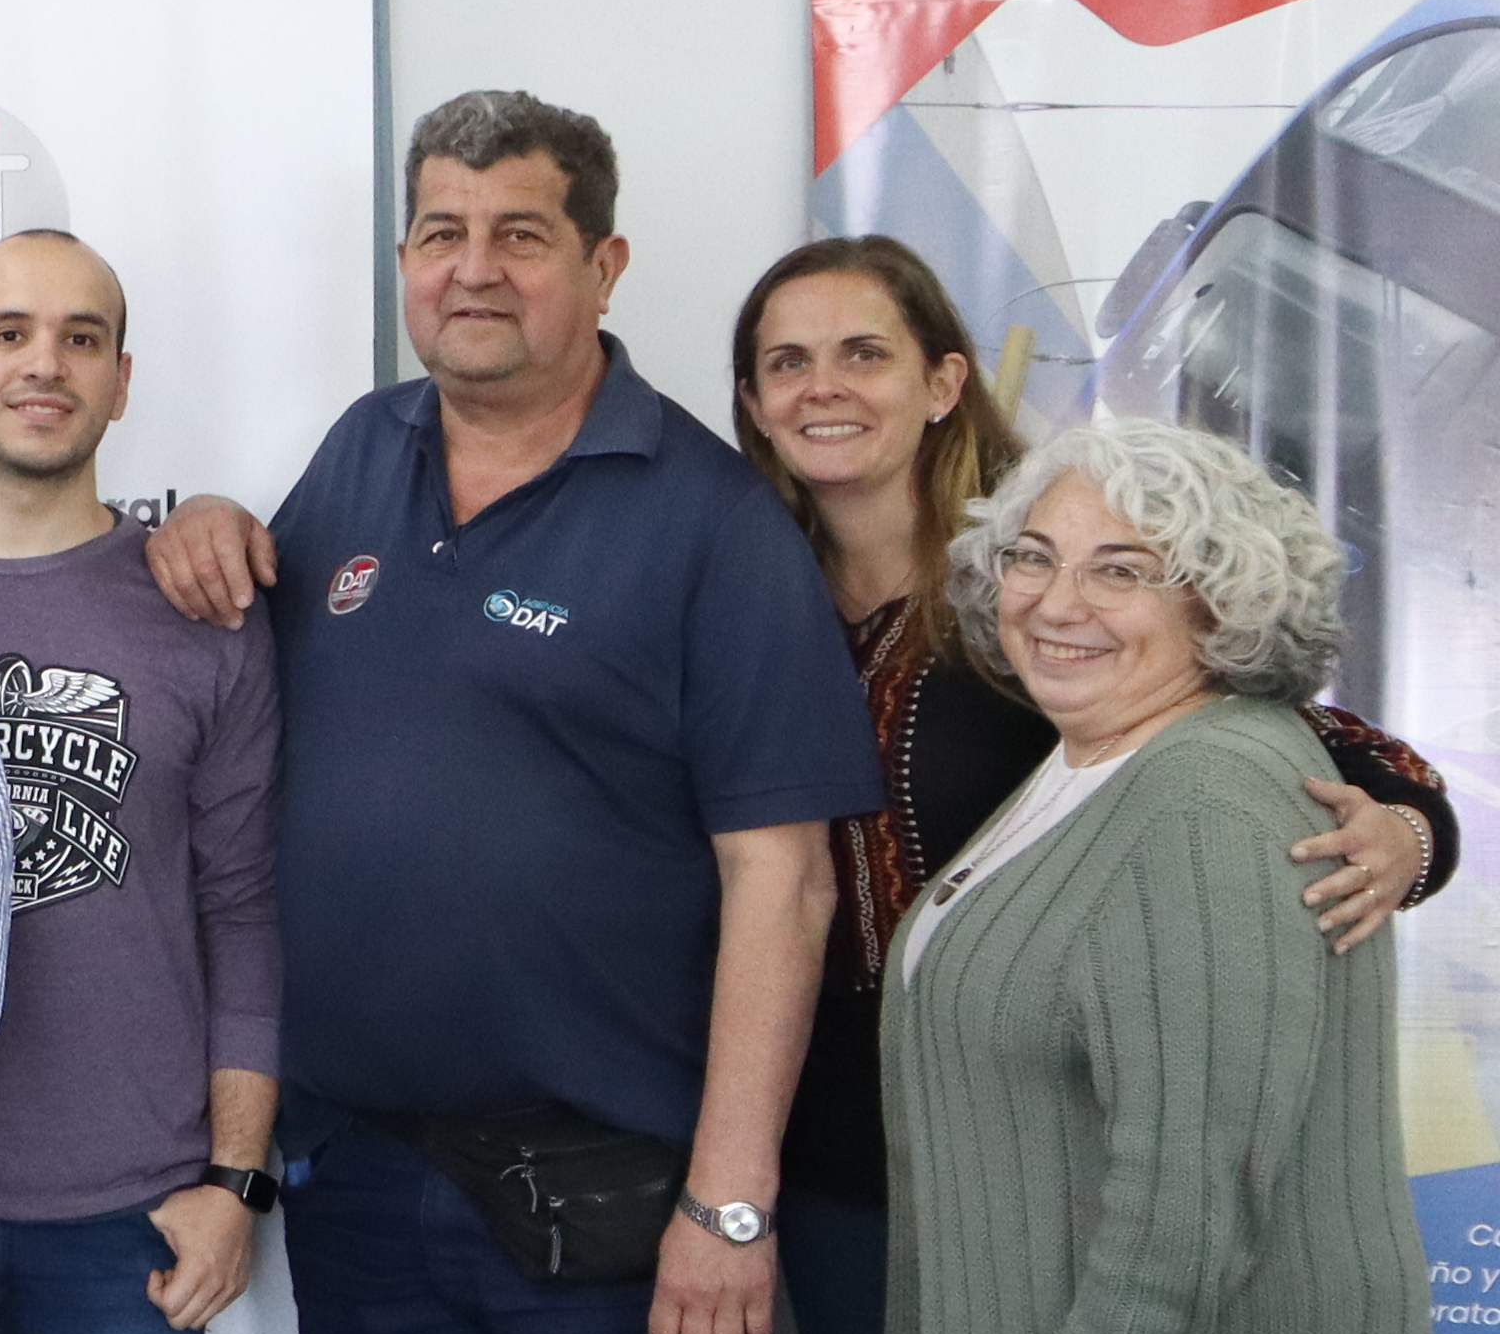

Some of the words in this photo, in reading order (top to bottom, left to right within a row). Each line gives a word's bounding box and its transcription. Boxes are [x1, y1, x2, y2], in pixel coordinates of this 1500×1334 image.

[337, 568, 376, 592] DAT
[510, 606, 568, 637] DAT
[62, 800, 123, 872] LIFE
